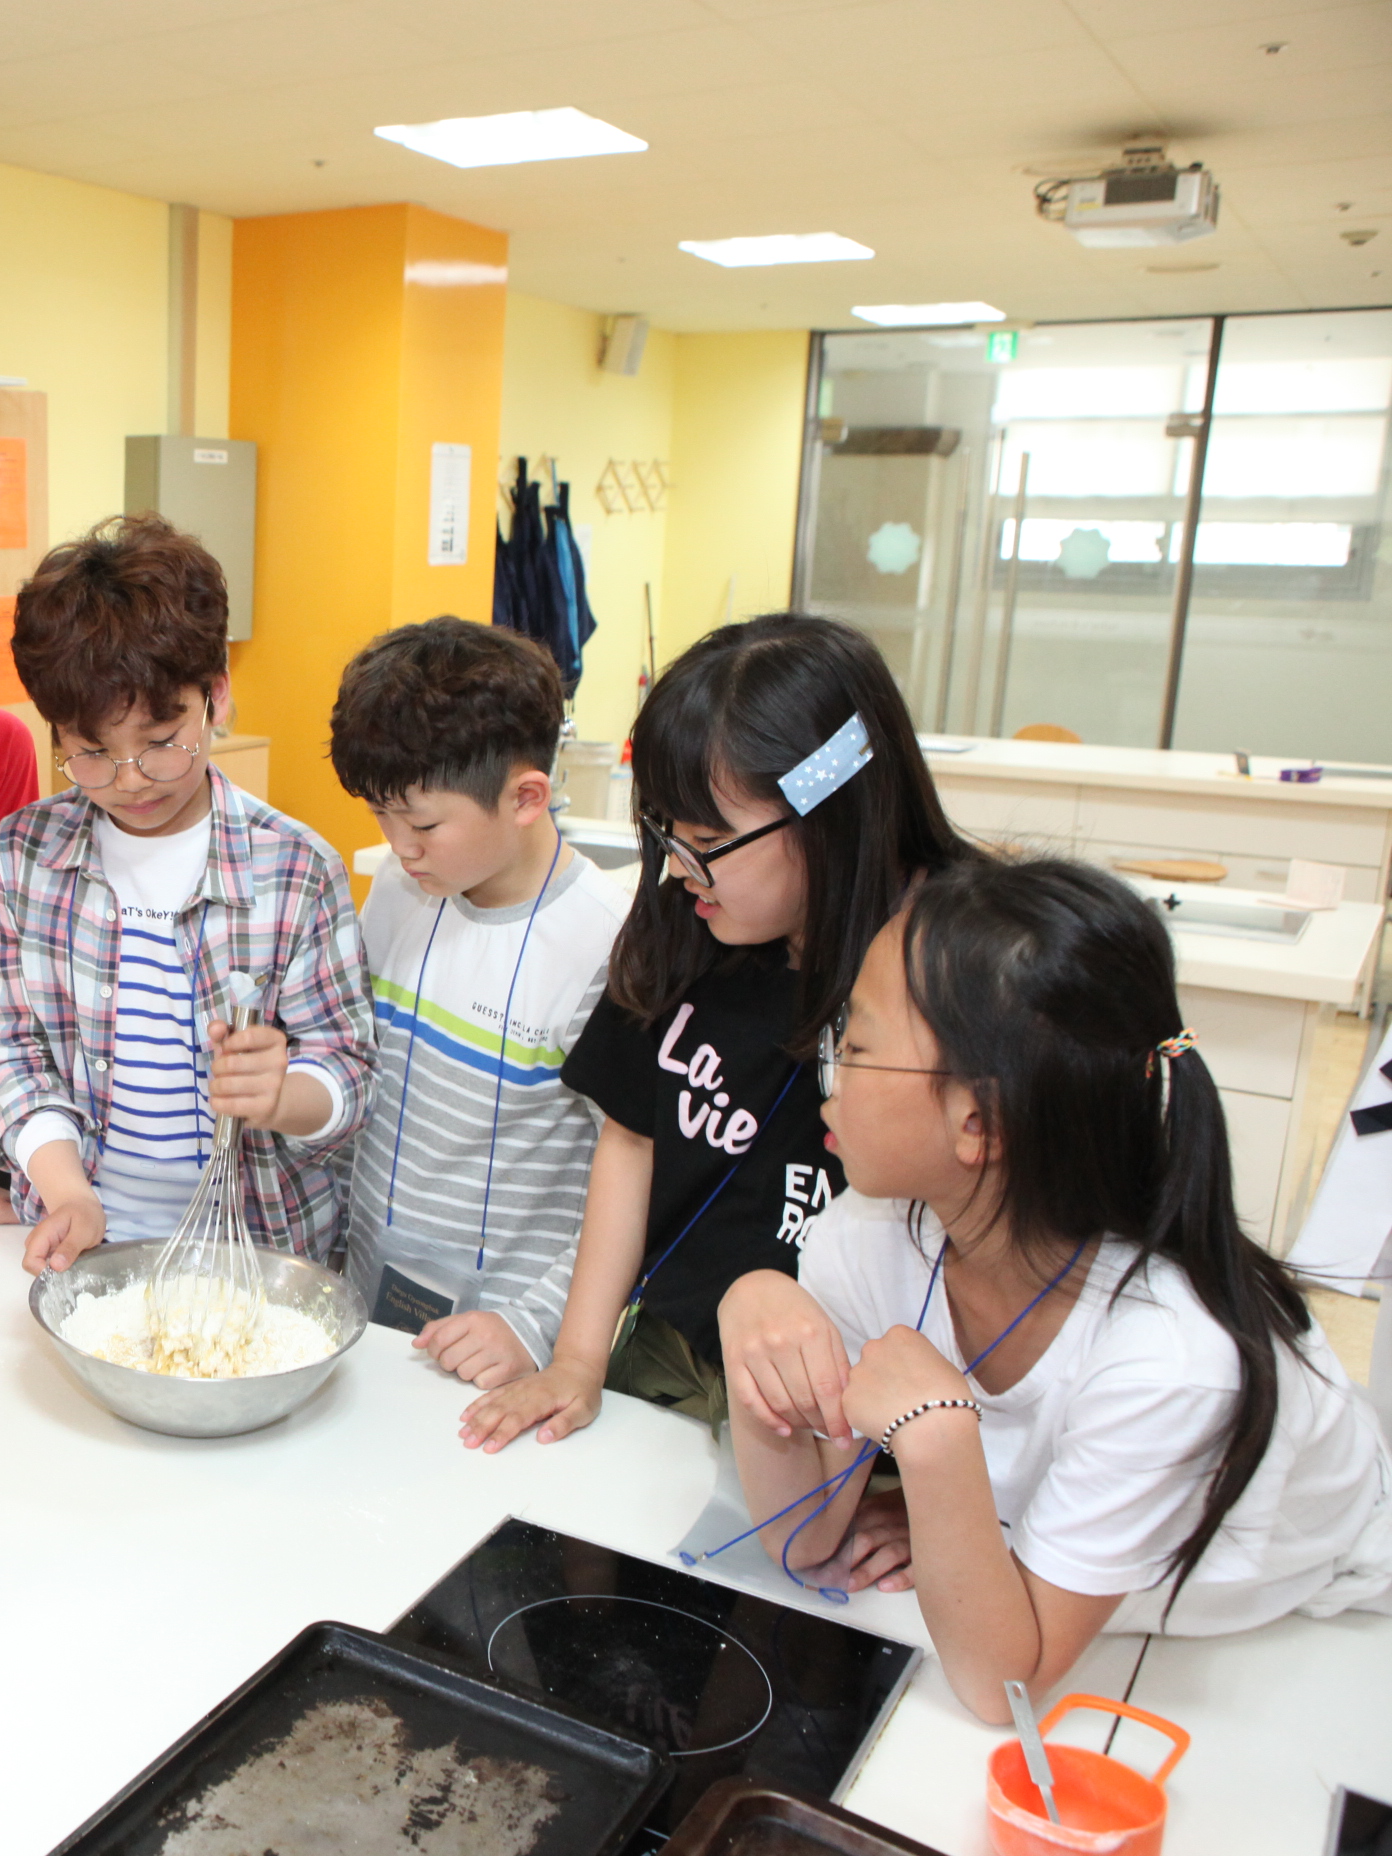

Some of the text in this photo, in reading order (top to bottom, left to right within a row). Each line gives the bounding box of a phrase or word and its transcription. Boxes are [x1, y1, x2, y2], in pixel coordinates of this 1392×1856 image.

[471, 1001, 504, 1022] GUESS?
[658, 1002, 723, 1090] La
[678, 1090, 758, 1155] vie
[386, 1291, 412, 1314] English
